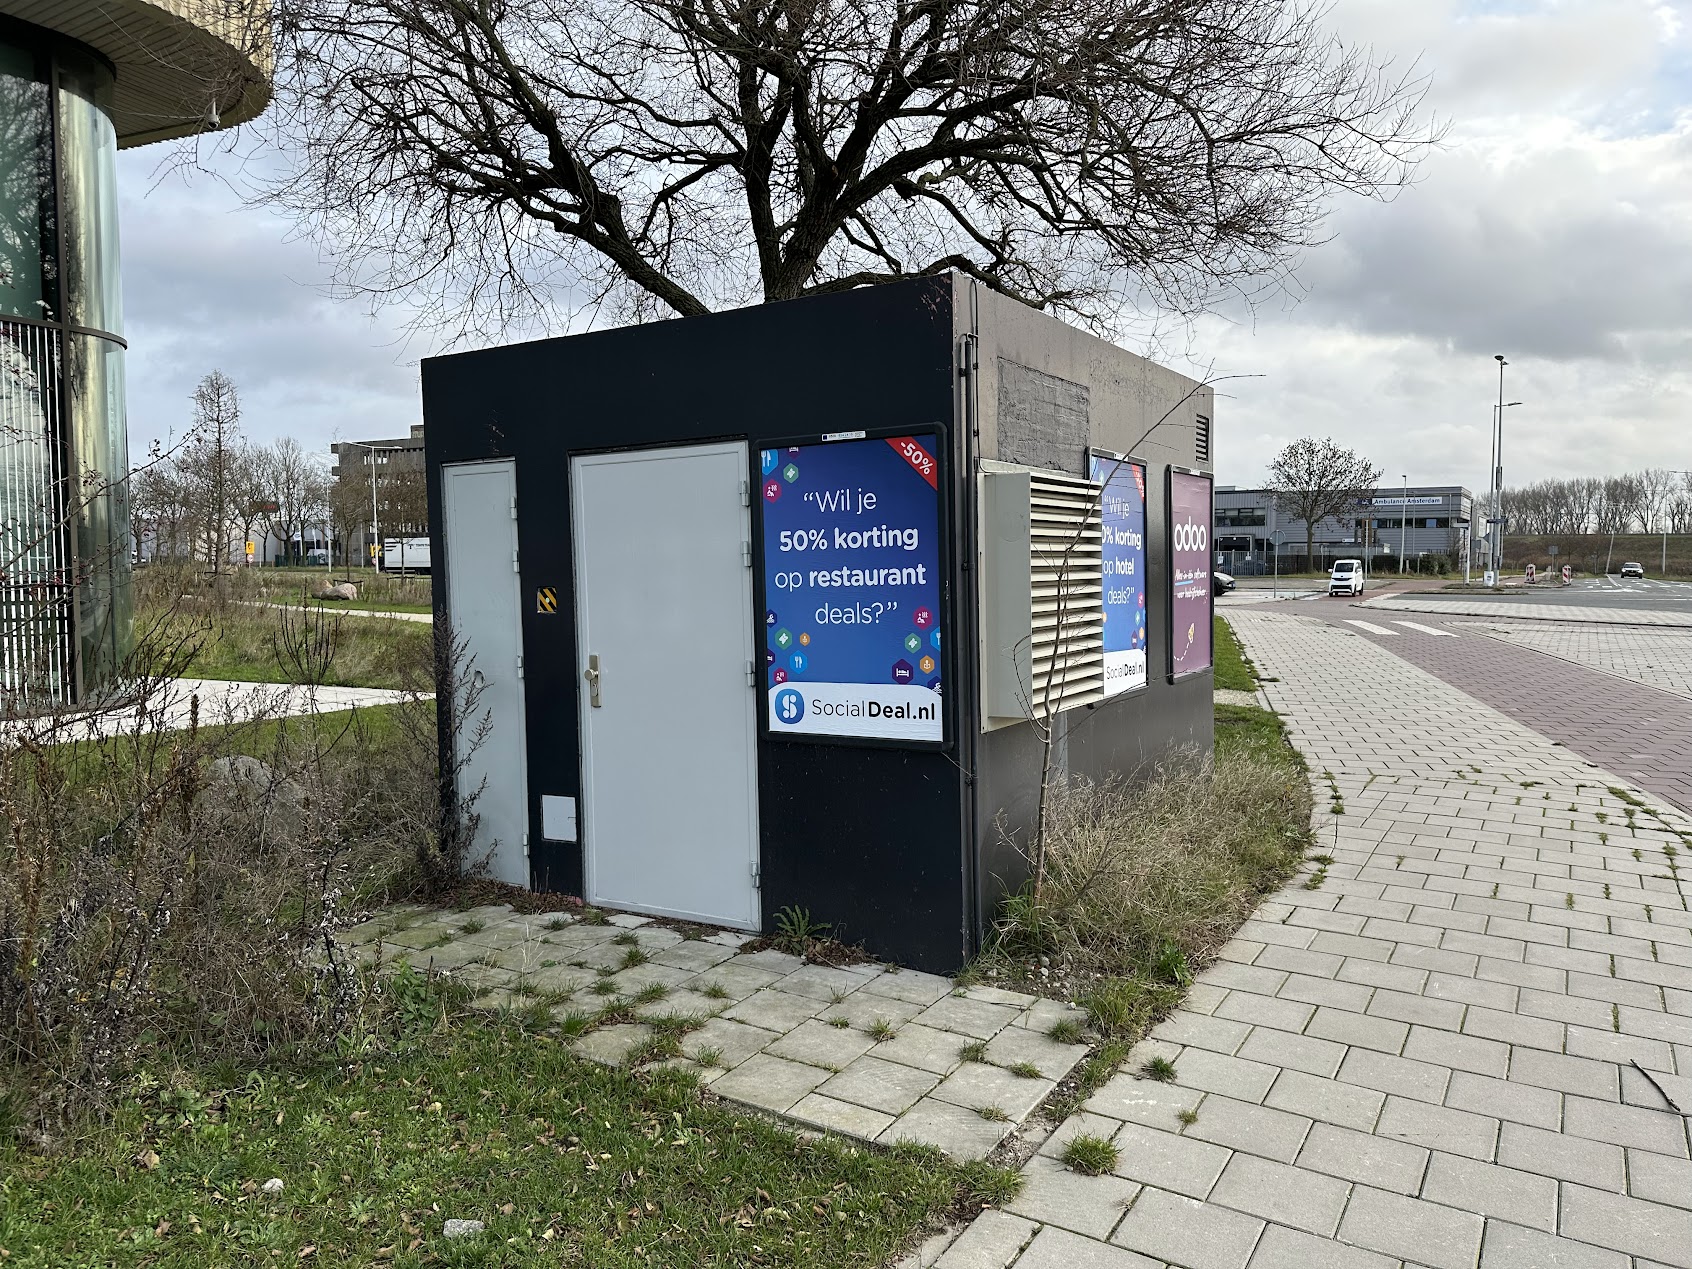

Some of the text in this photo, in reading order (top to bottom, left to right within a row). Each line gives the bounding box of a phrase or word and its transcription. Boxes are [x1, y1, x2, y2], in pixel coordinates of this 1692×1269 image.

[900, 441, 933, 475] -50%
[856, 487, 877, 515] je
[1122, 498, 1130, 520] je
[779, 524, 919, 552] 50% korting
[1115, 526, 1142, 551] korting
[1174, 515, 1207, 552] odoo
[774, 563, 927, 592] op restaurant
[1103, 556, 1134, 578] op hotel
[1106, 661, 1145, 680] SocialDeal.nl
[812, 698, 935, 721] SocialDeal.nl
